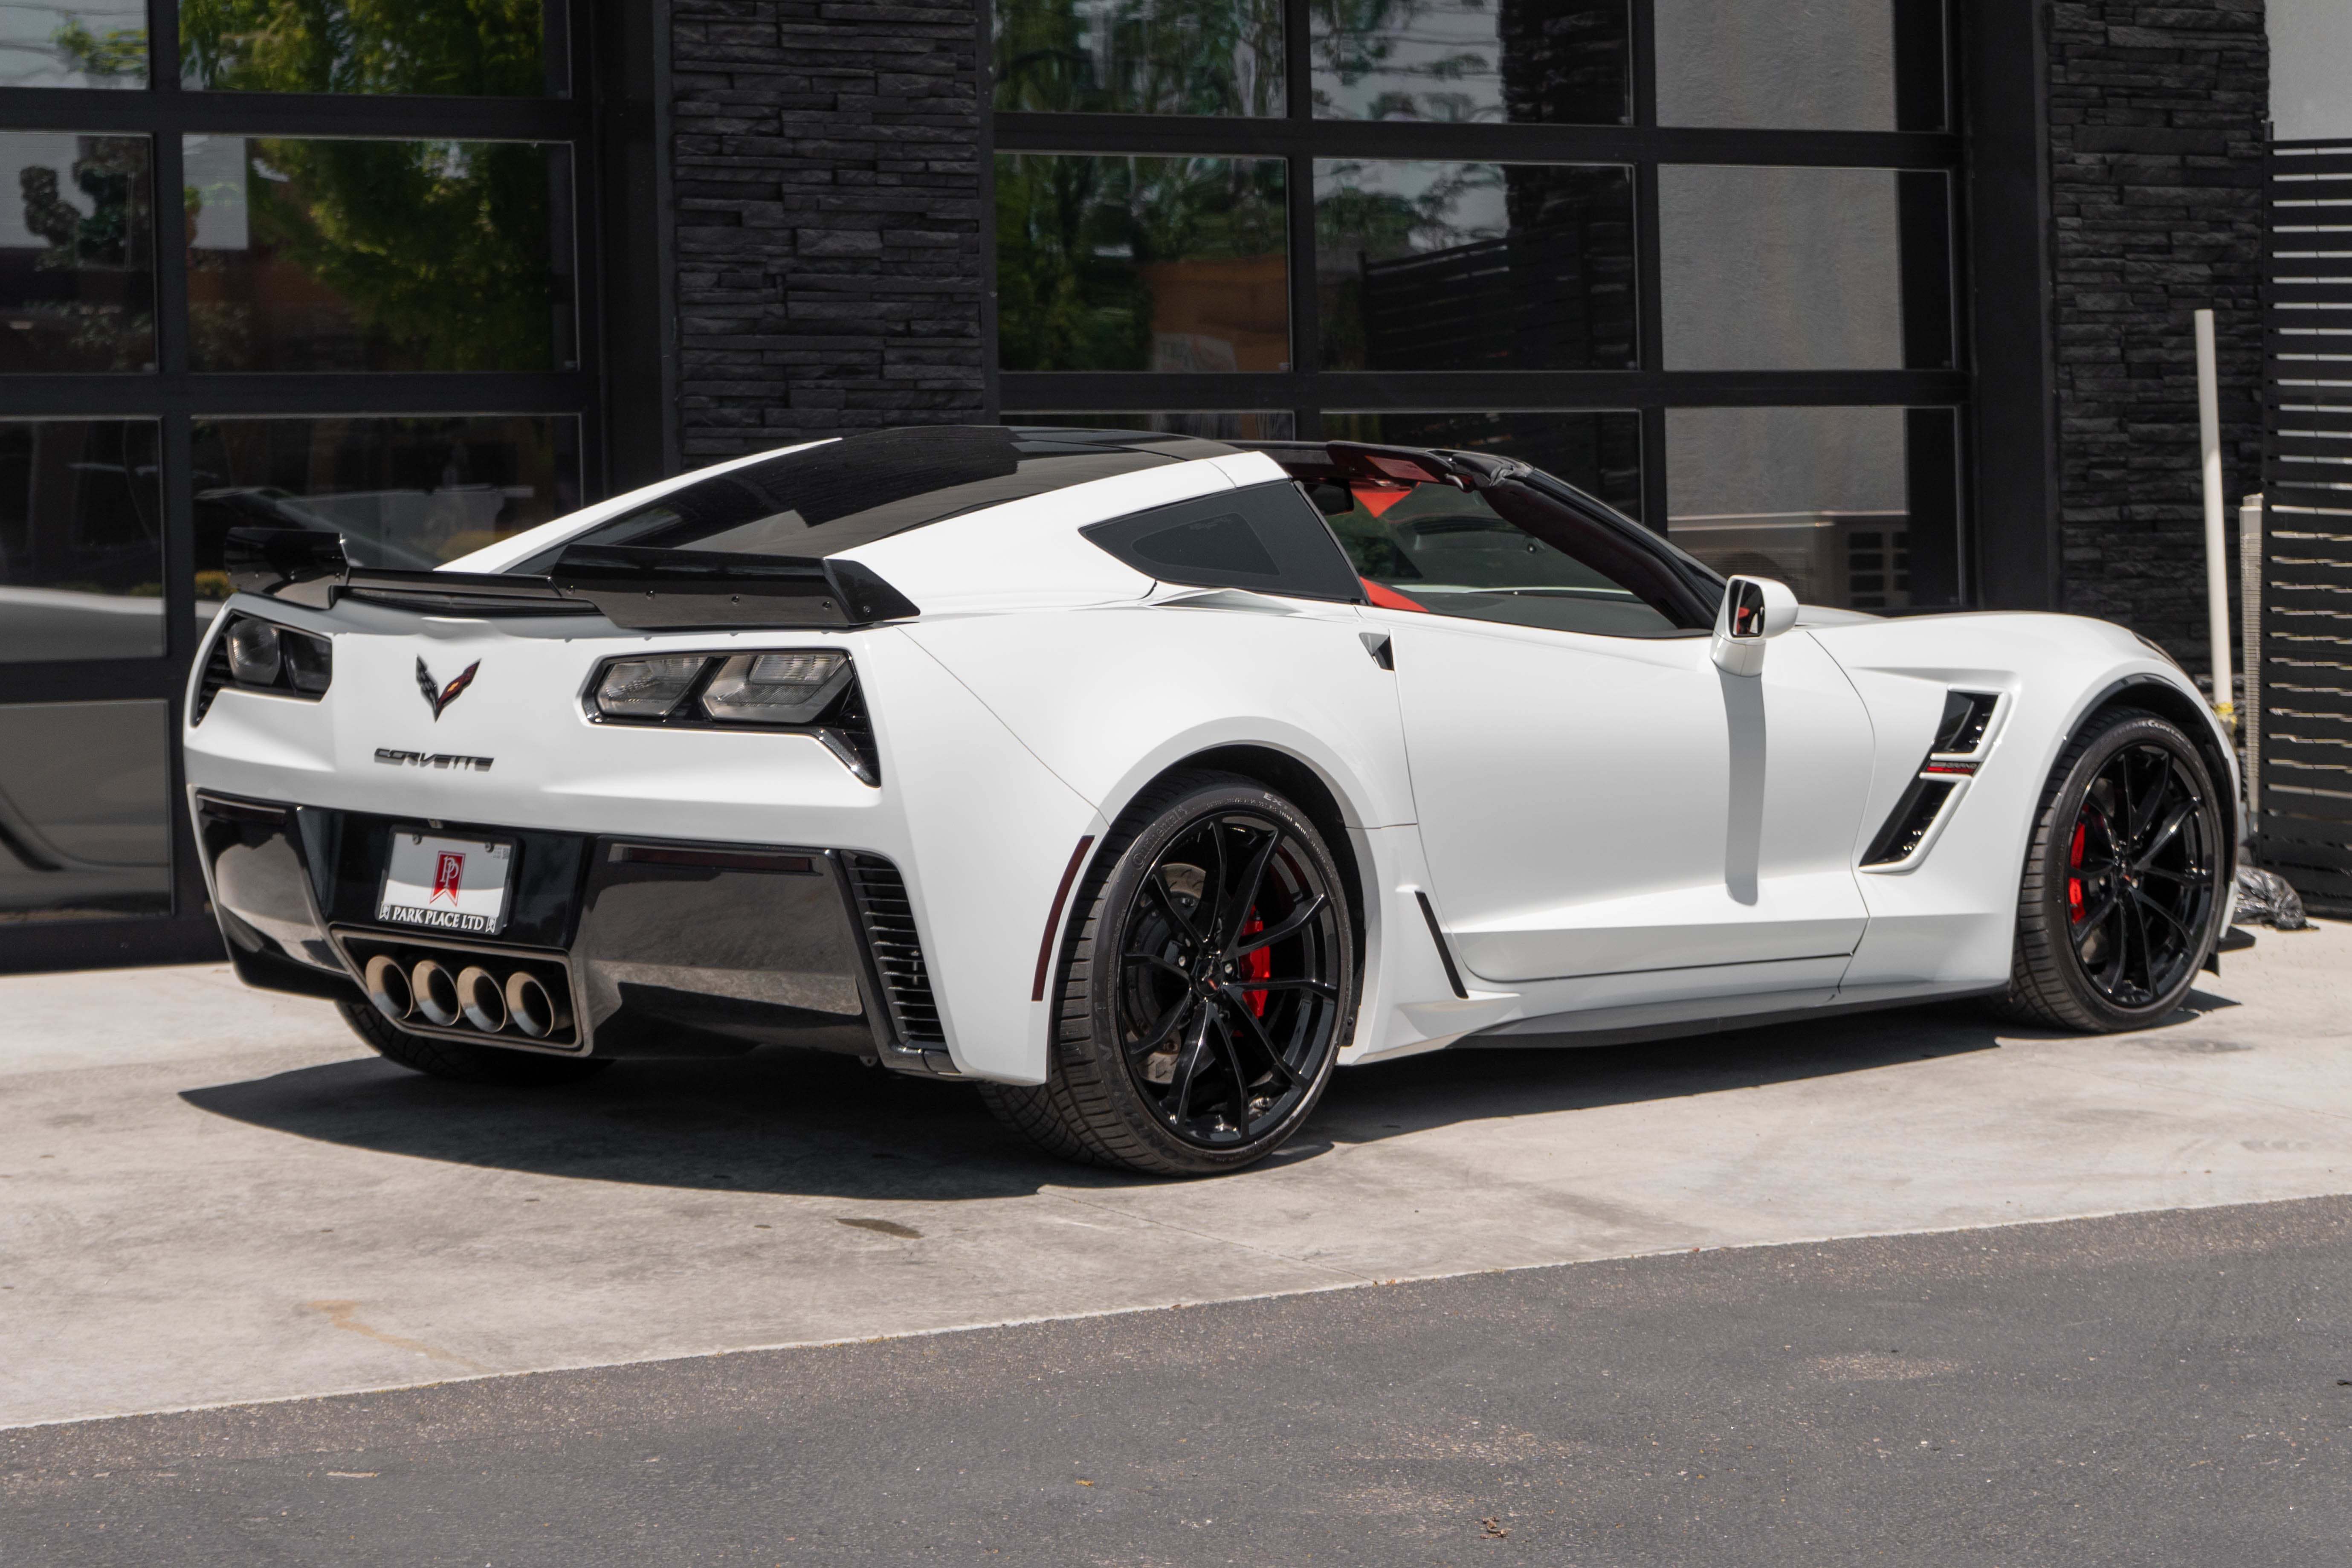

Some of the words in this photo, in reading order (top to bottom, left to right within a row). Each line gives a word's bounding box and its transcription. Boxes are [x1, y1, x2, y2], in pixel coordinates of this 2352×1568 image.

[374, 748, 494, 766] CORVETTE
[392, 906, 424, 924] PARK
[425, 910, 460, 928] PLACE
[461, 914, 484, 931] LTD
